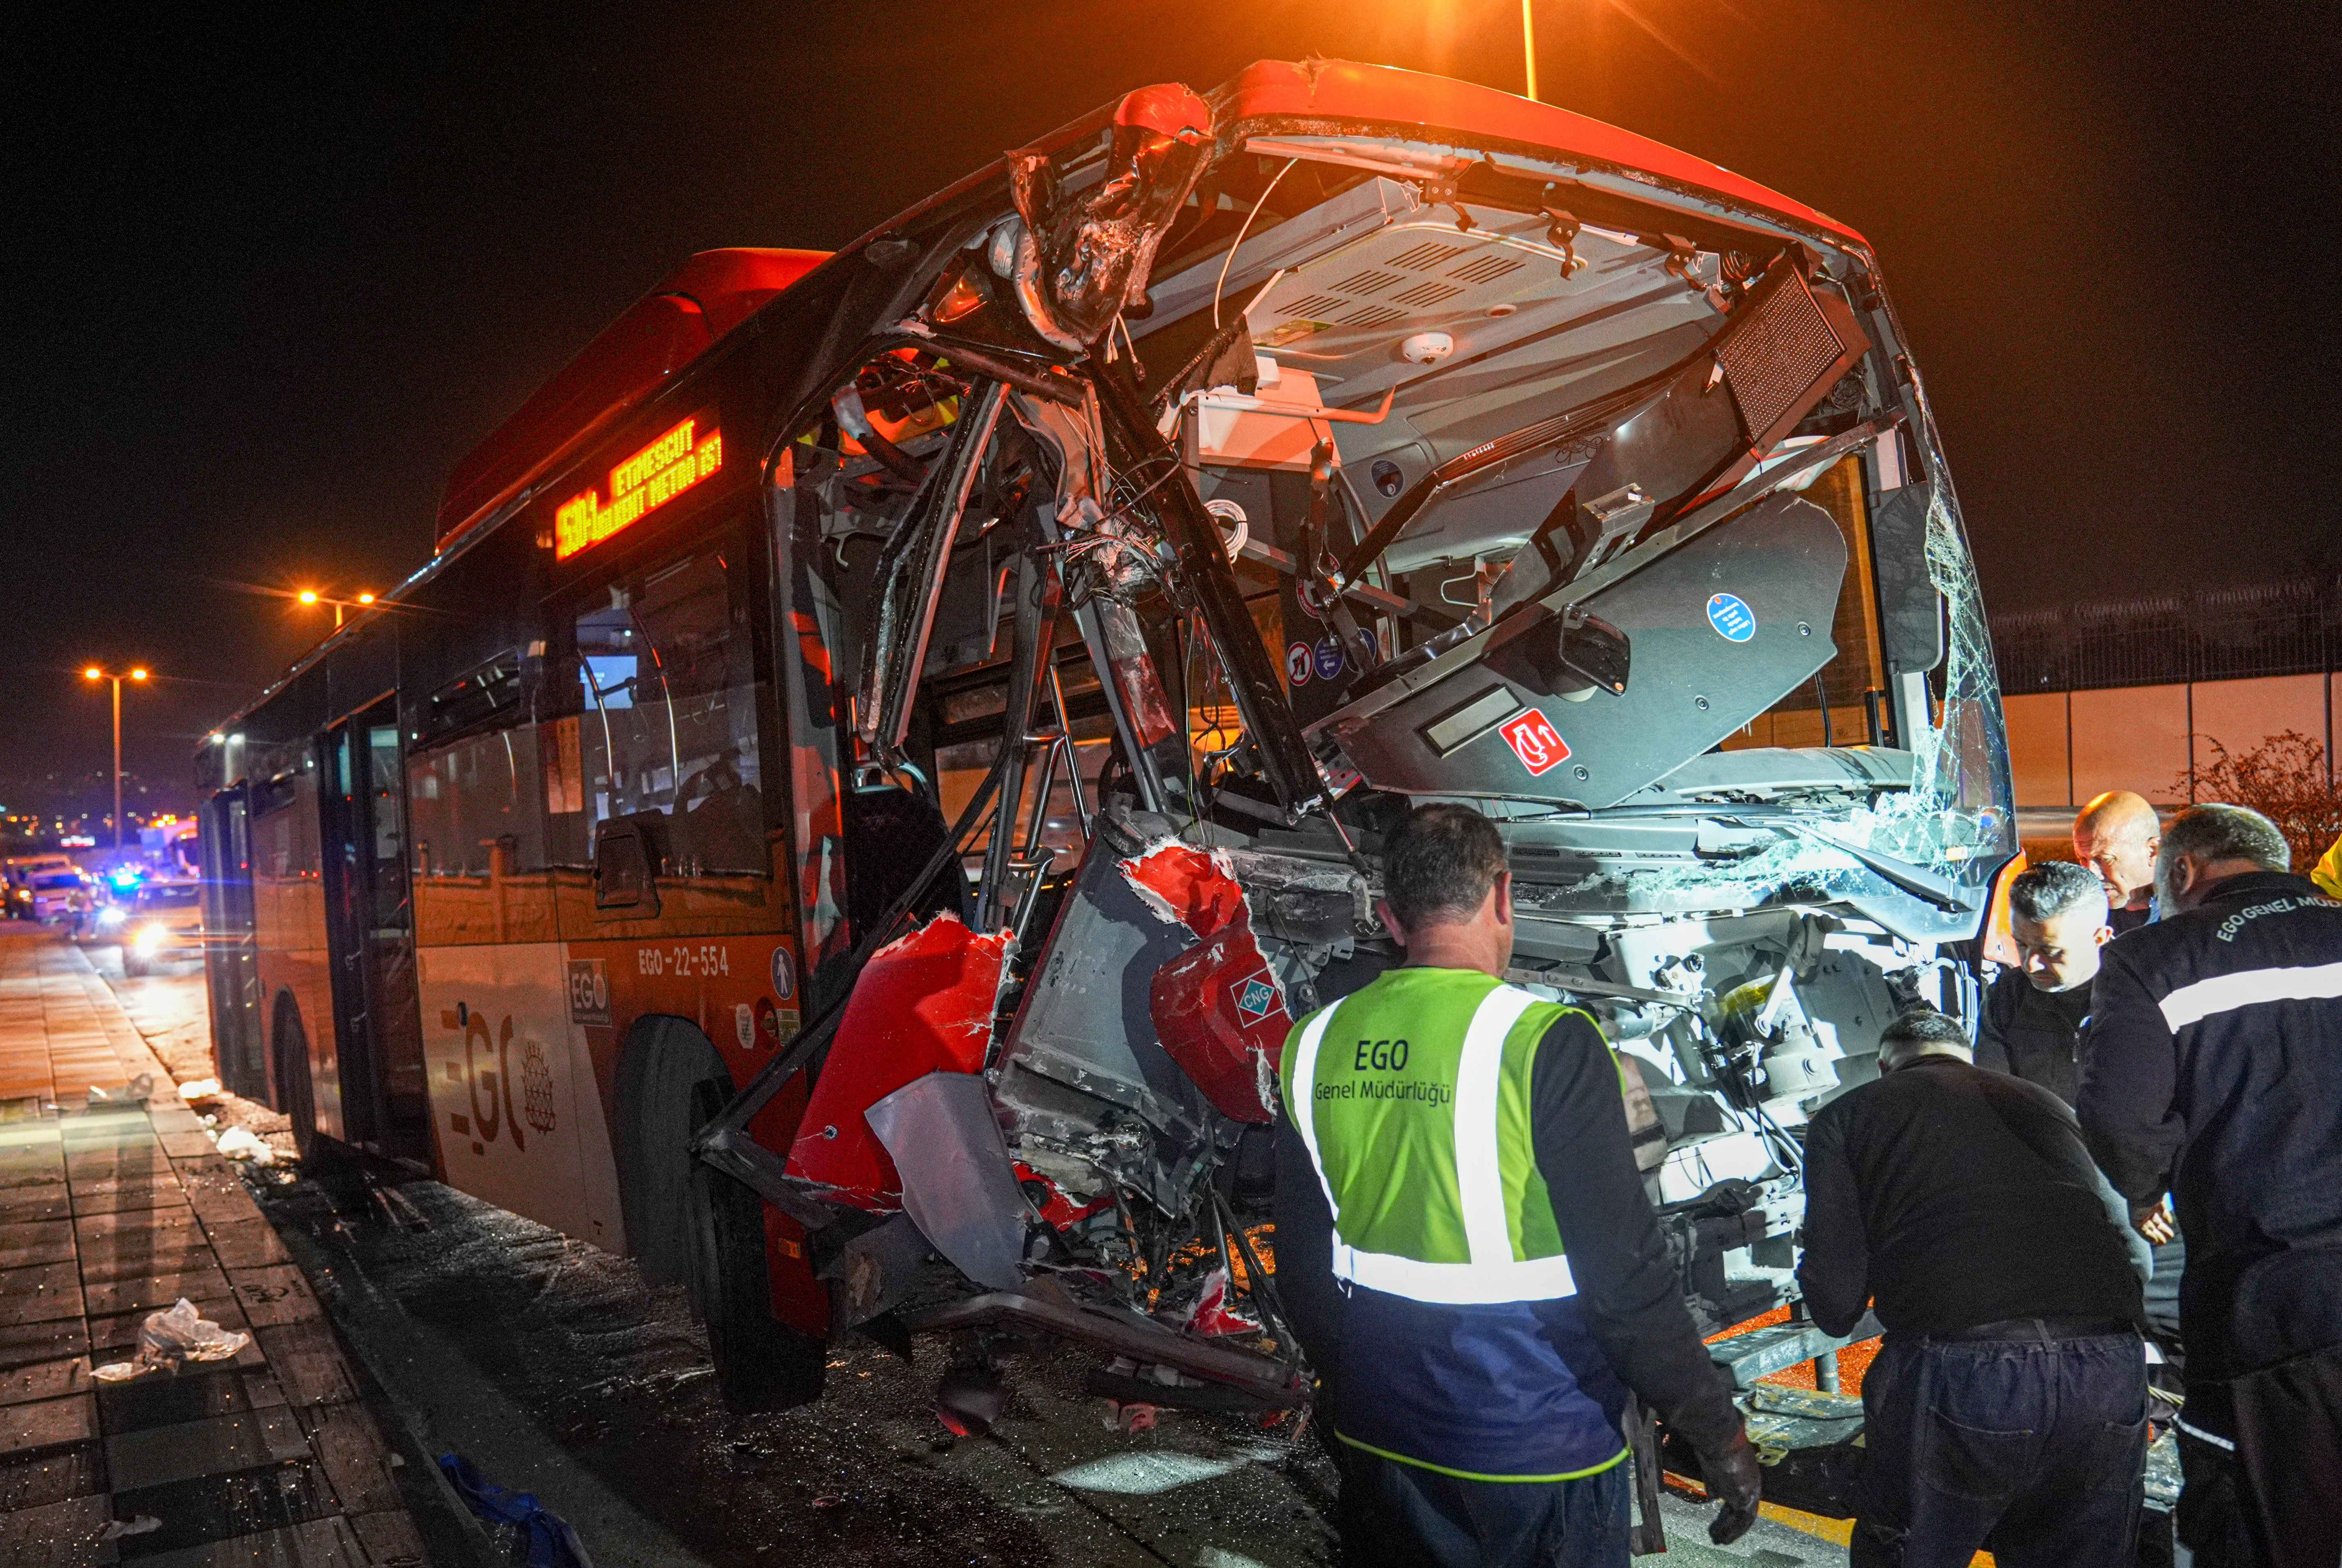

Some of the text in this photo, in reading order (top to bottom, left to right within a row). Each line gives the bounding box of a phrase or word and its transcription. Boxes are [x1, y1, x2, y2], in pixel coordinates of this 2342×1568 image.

[650, 453, 696, 506] METRO
[2217, 915, 2245, 942] EGO
[2242, 898, 2296, 919] GENEL
[639, 946, 729, 976] EGO-22-554
[571, 973, 606, 1010] EGO
[1244, 987, 1270, 1008] CNG
[1355, 1039, 1409, 1071] EGO
[1315, 1080, 1451, 1108] Genel Müdürlüğü
